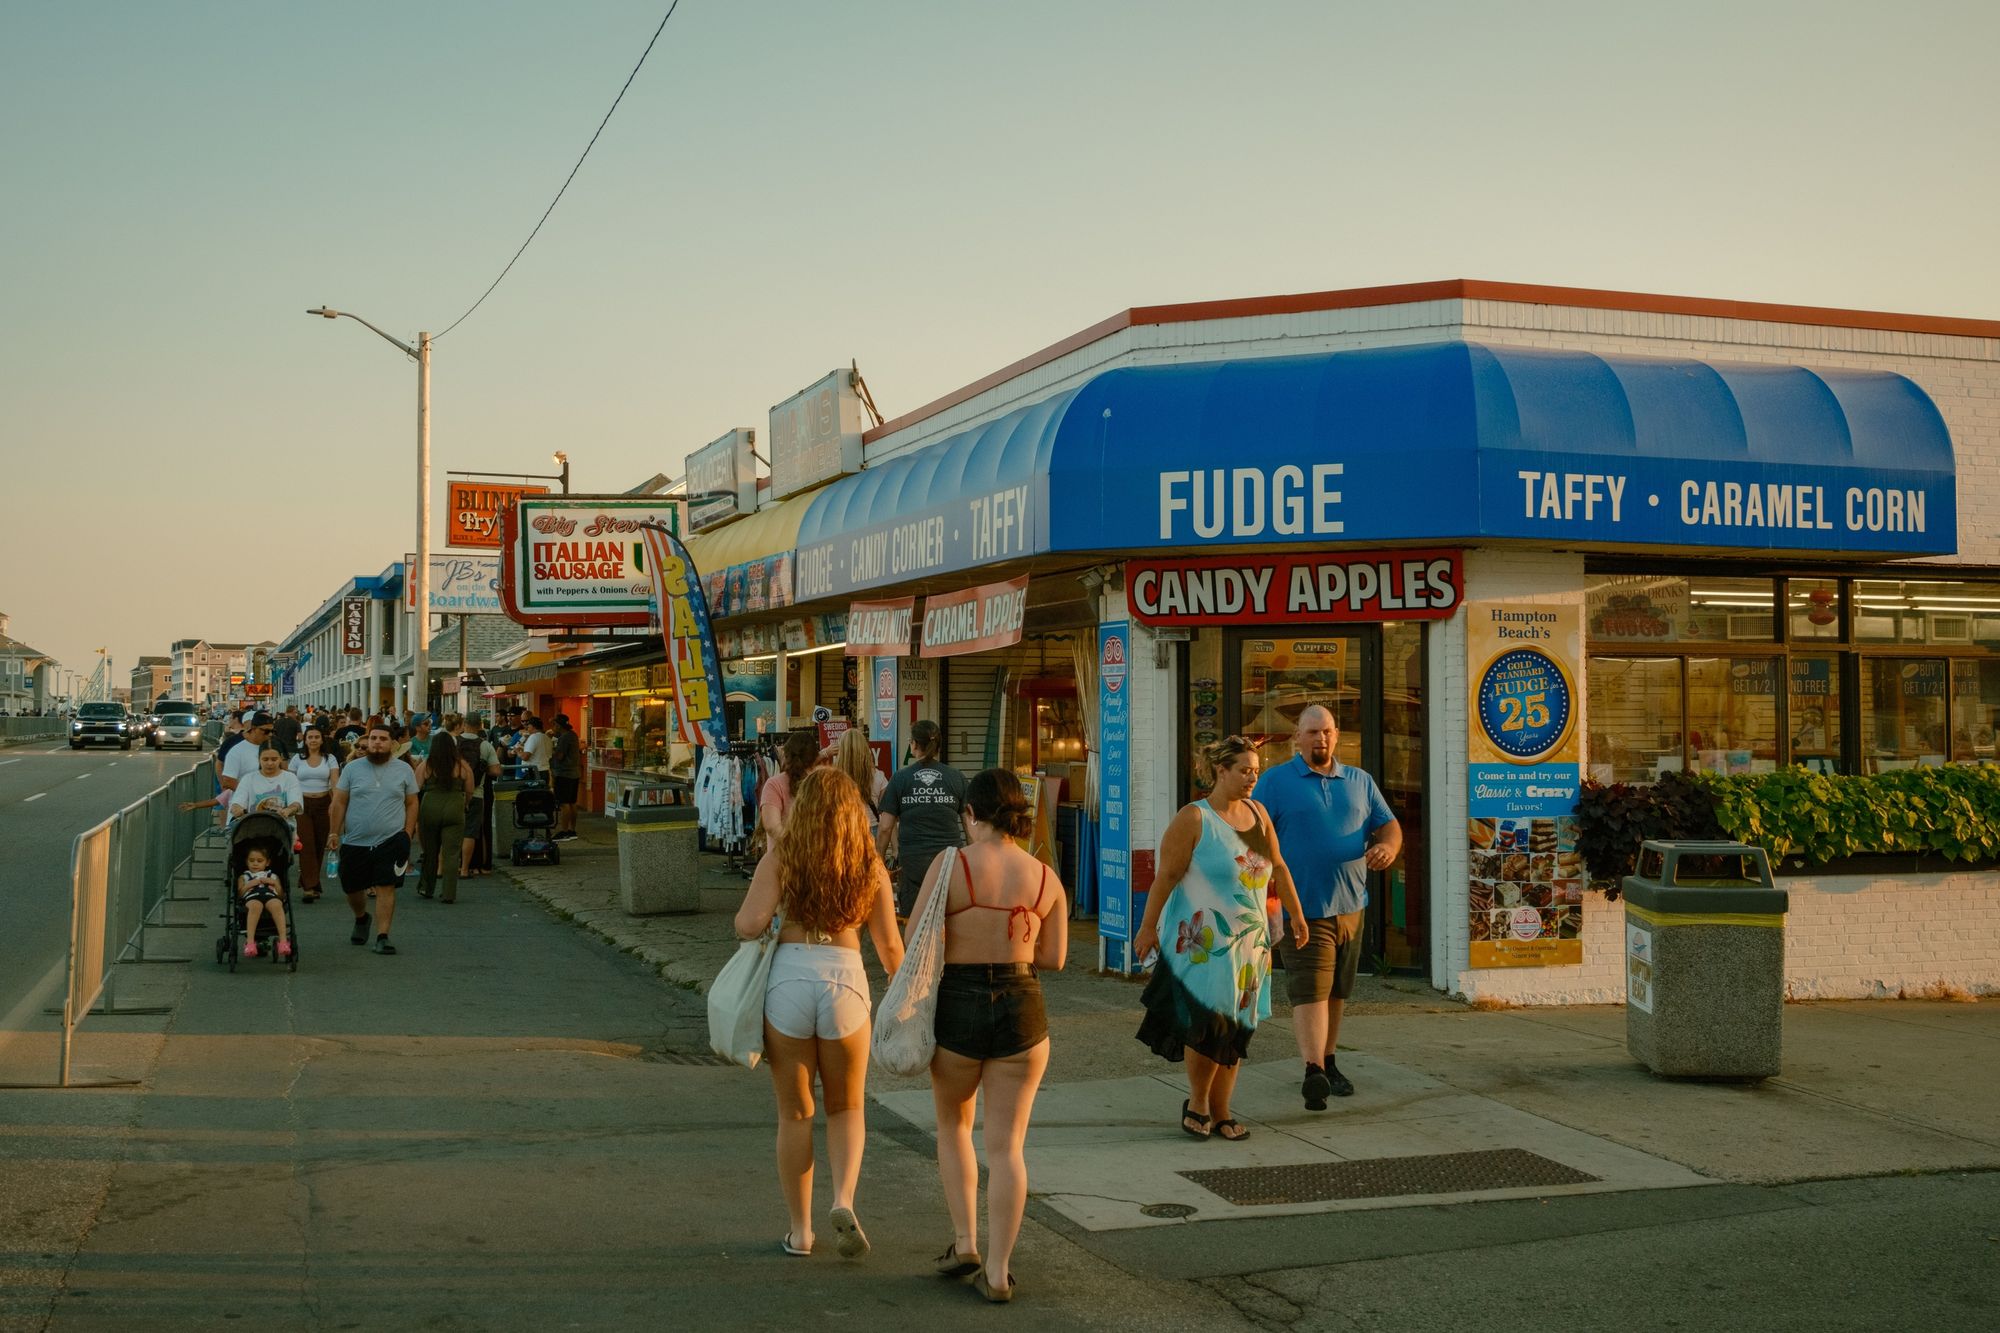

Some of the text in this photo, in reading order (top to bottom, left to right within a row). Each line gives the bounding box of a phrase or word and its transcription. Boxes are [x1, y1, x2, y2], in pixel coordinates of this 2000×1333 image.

[1160, 463, 1344, 540] FUDGE
[1518, 470, 1926, 533] TAFFY CARAMEL CORN
[532, 514, 577, 537] Big
[799, 485, 1028, 597] FUDGE CANDY CORNER TAFFY
[533, 542, 624, 562] ITALIAN
[534, 562, 625, 580] SAUSAGE
[537, 587, 553, 595] with
[556, 587, 589, 597] Peppers
[1133, 559, 1456, 616] CANDY APPLES
[1648, 585, 1685, 600] DRINKS
[923, 586, 1028, 647] CARAMEL APPLES
[1491, 609, 1557, 625] Hampton
[347, 602, 362, 649] CASINO
[850, 607, 912, 645] GLAZED NUTS
[1498, 626, 1550, 638] Beach's
[1294, 644, 1336, 652] APPLES
[904, 659, 924, 670] SALT
[1507, 660, 1532, 671] GOLD
[1751, 662, 1768, 675] BUY
[1920, 663, 1936, 676] BUY
[901, 671, 928, 681] WATER
[1496, 667, 1545, 680] STANDARD
[1494, 677, 1549, 696] FUDGE
[1733, 680, 1750, 693] GET
[1805, 681, 1827, 694] FREE
[1904, 681, 1919, 695] GET
[1499, 692, 1550, 732] 25
[1478, 771, 1571, 782] Come in and try our
[912, 787, 945, 795] LOCAL
[1475, 784, 1574, 799] Classic & Crazy
[902, 796, 931, 804] SINCE
[1506, 802, 1543, 811] flavors!
